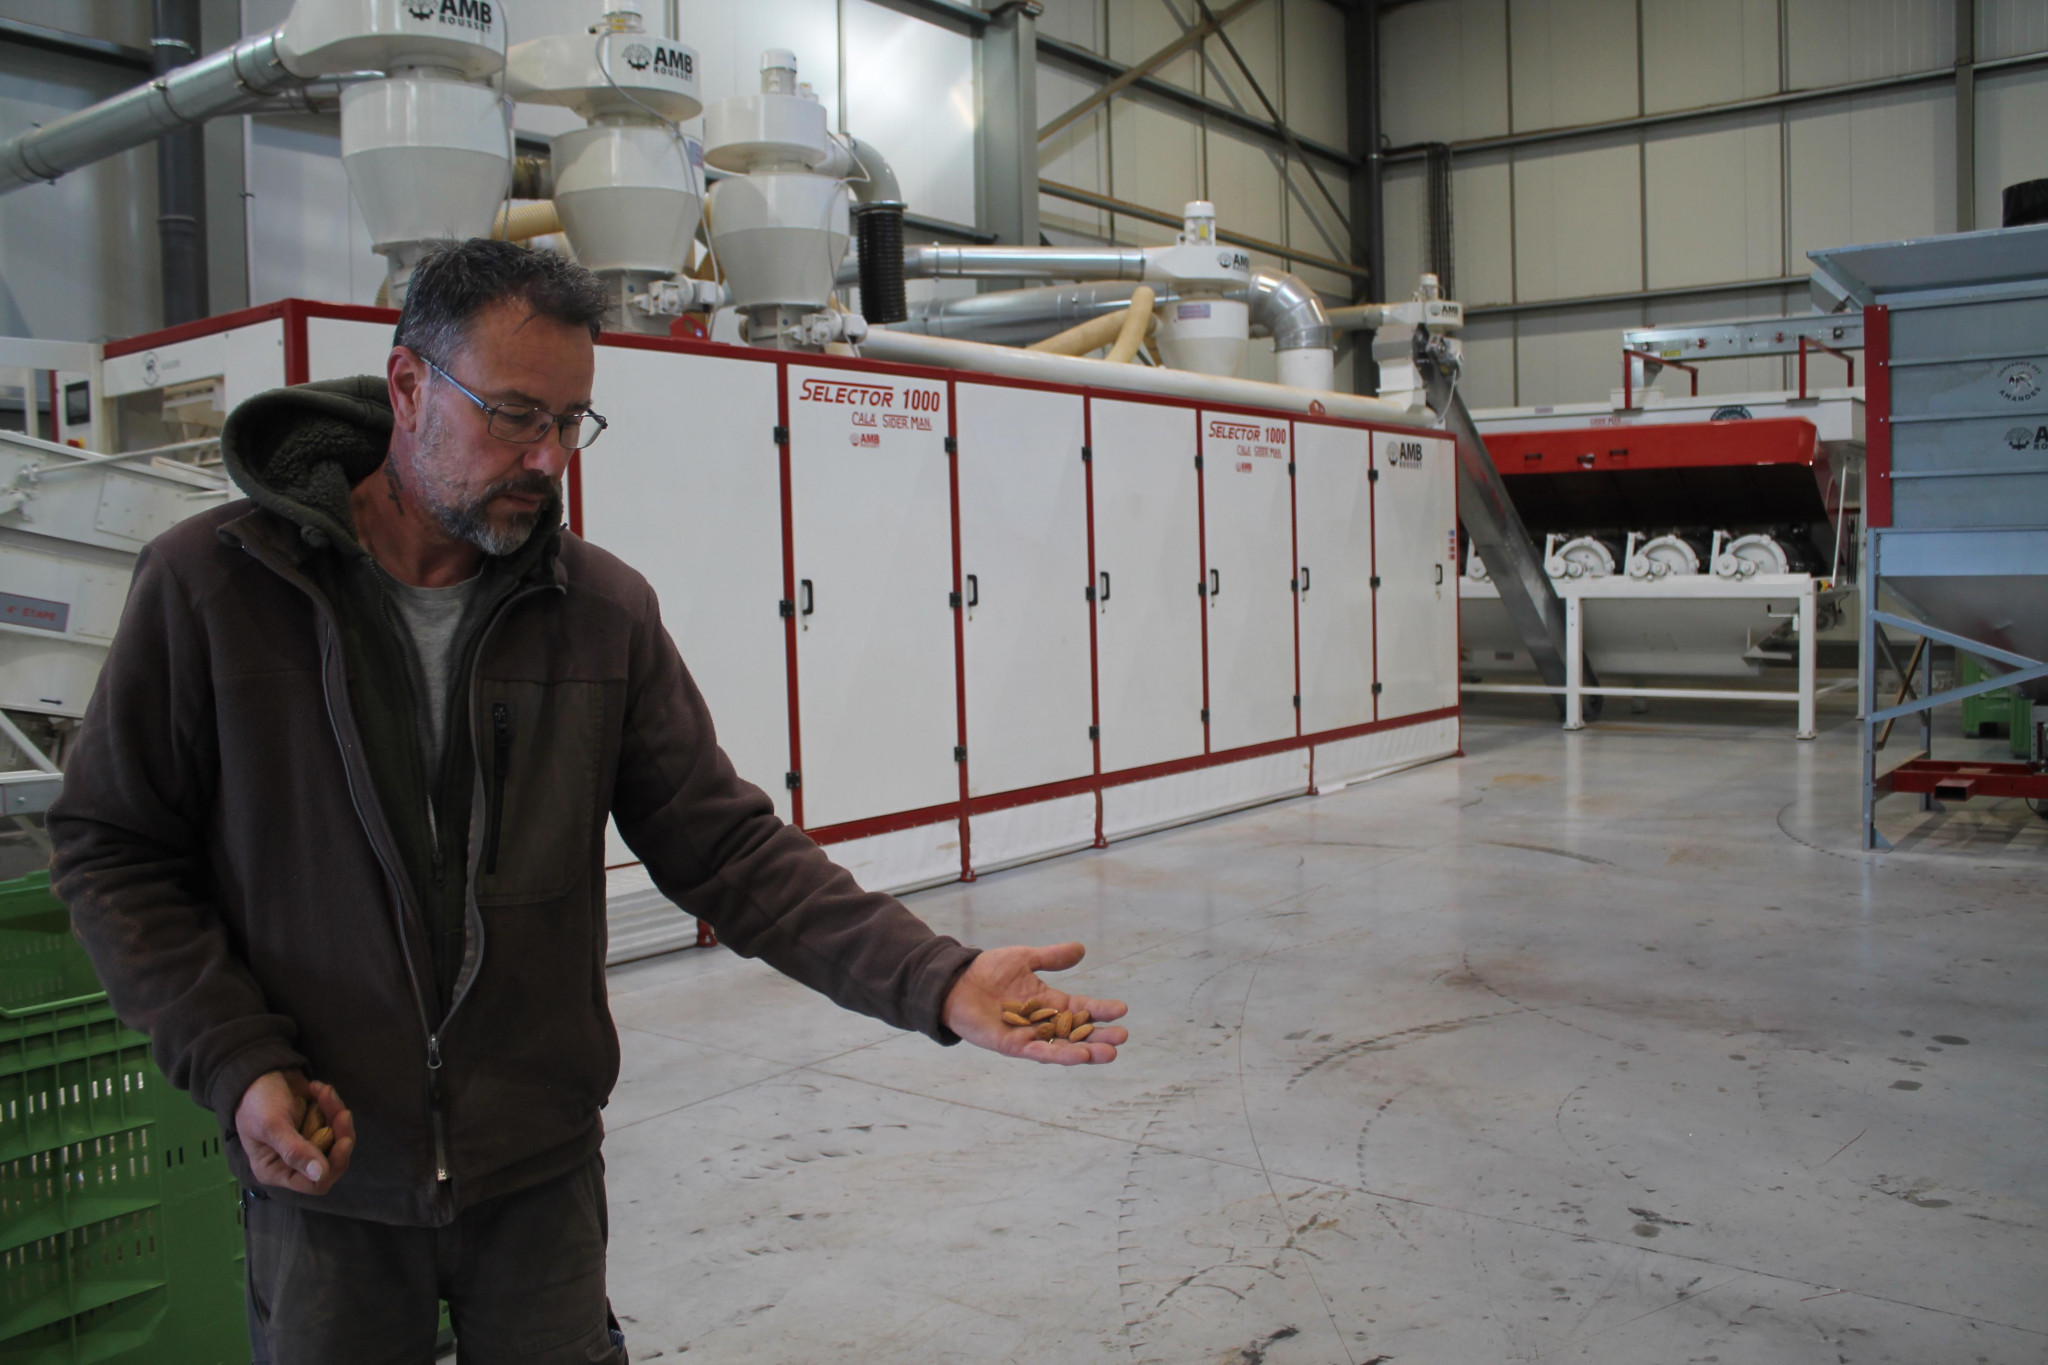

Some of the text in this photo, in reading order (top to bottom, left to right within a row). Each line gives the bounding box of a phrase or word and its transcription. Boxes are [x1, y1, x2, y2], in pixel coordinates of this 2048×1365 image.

[439, 0, 492, 24] AMB
[439, 15, 491, 34] ROUSSET
[654, 46, 693, 74] AMB
[799, 378, 941, 413] SELECTOR 1000
[1999, 386, 2042, 402] AMANDES
[860, 433, 880, 444] AMB
[1209, 421, 1287, 444] SELECTOR 1000
[1399, 442, 1423, 462] AMB
